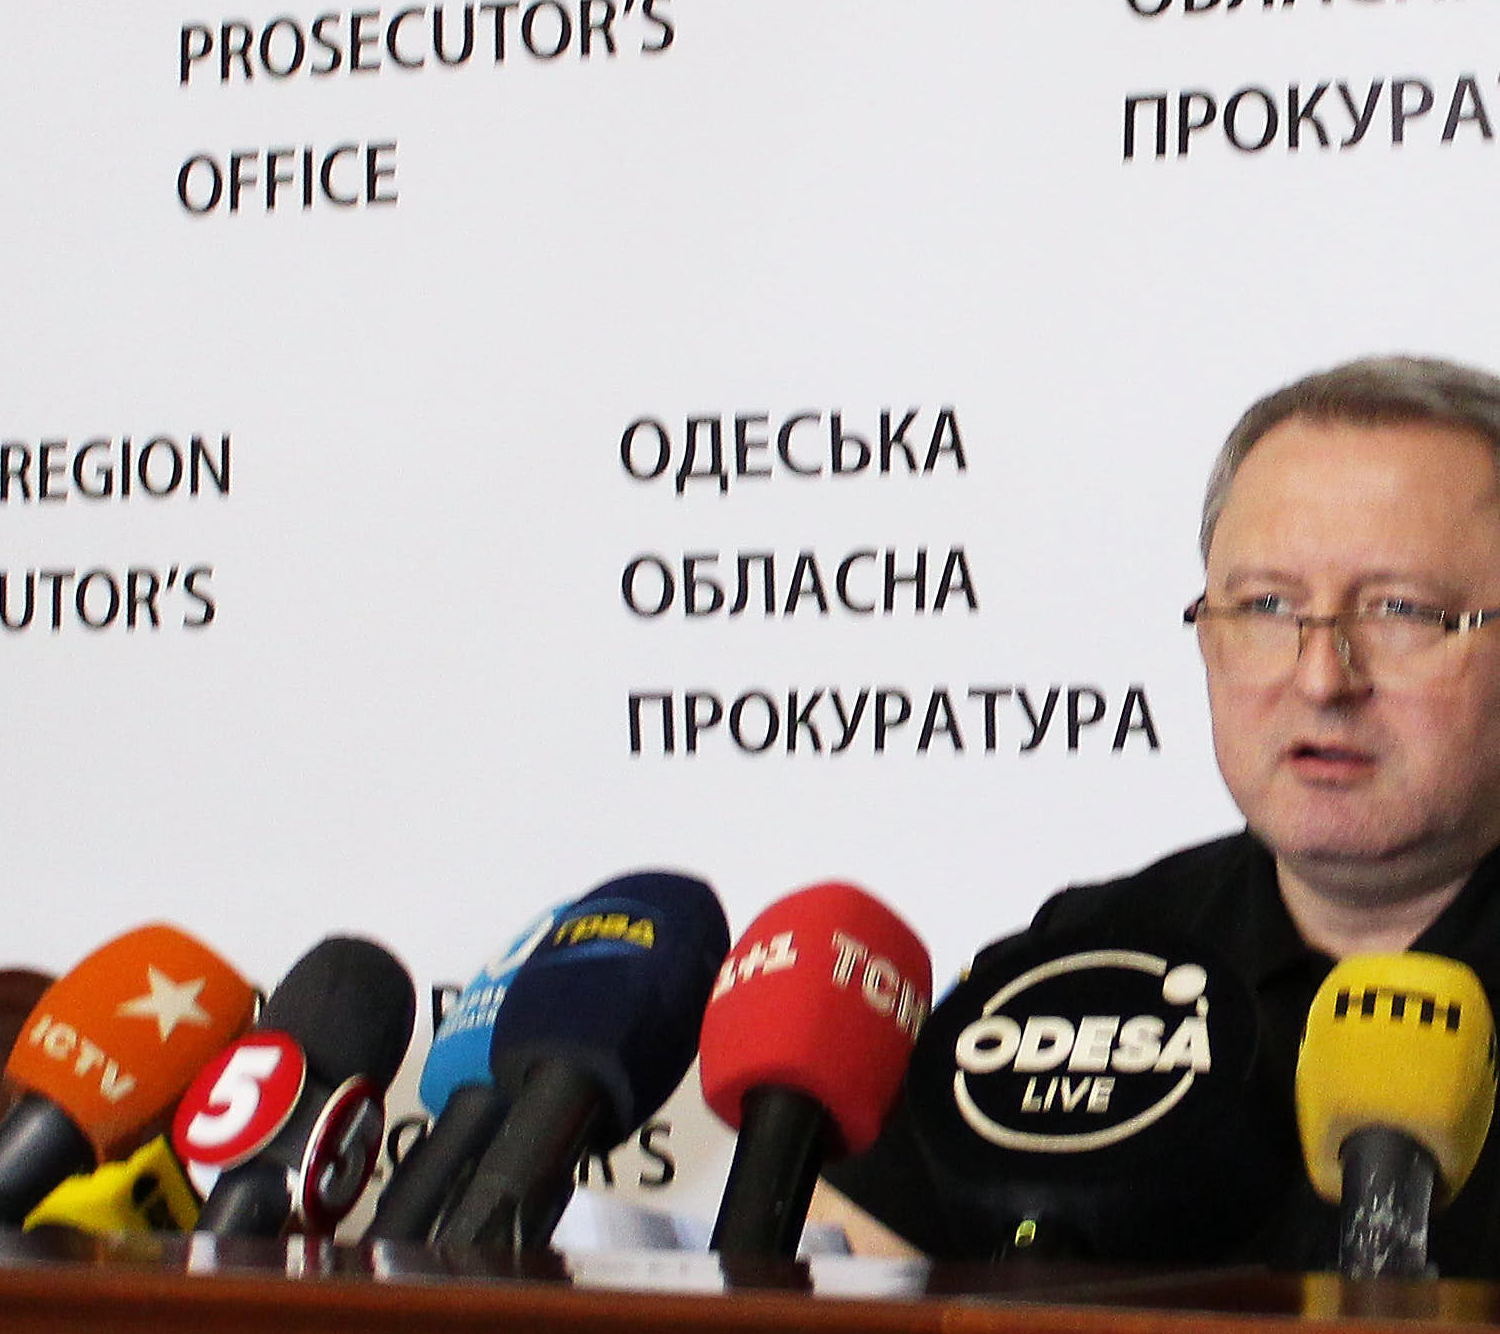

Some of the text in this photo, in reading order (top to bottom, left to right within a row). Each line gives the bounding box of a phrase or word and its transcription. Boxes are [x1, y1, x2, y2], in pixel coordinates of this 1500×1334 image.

[175, 141, 399, 216] OFFICE
[618, 407, 968, 497] ОДЕСЬКА
[619, 546, 980, 620] ОБЛАСНА
[626, 685, 1161, 756] ПРОКУРАТУРА
[28, 1013, 137, 1104] ICTV
[954, 999, 1211, 1075] ODESA
[186, 1046, 283, 1147] 5
[1020, 1076, 1116, 1114] LIVE
